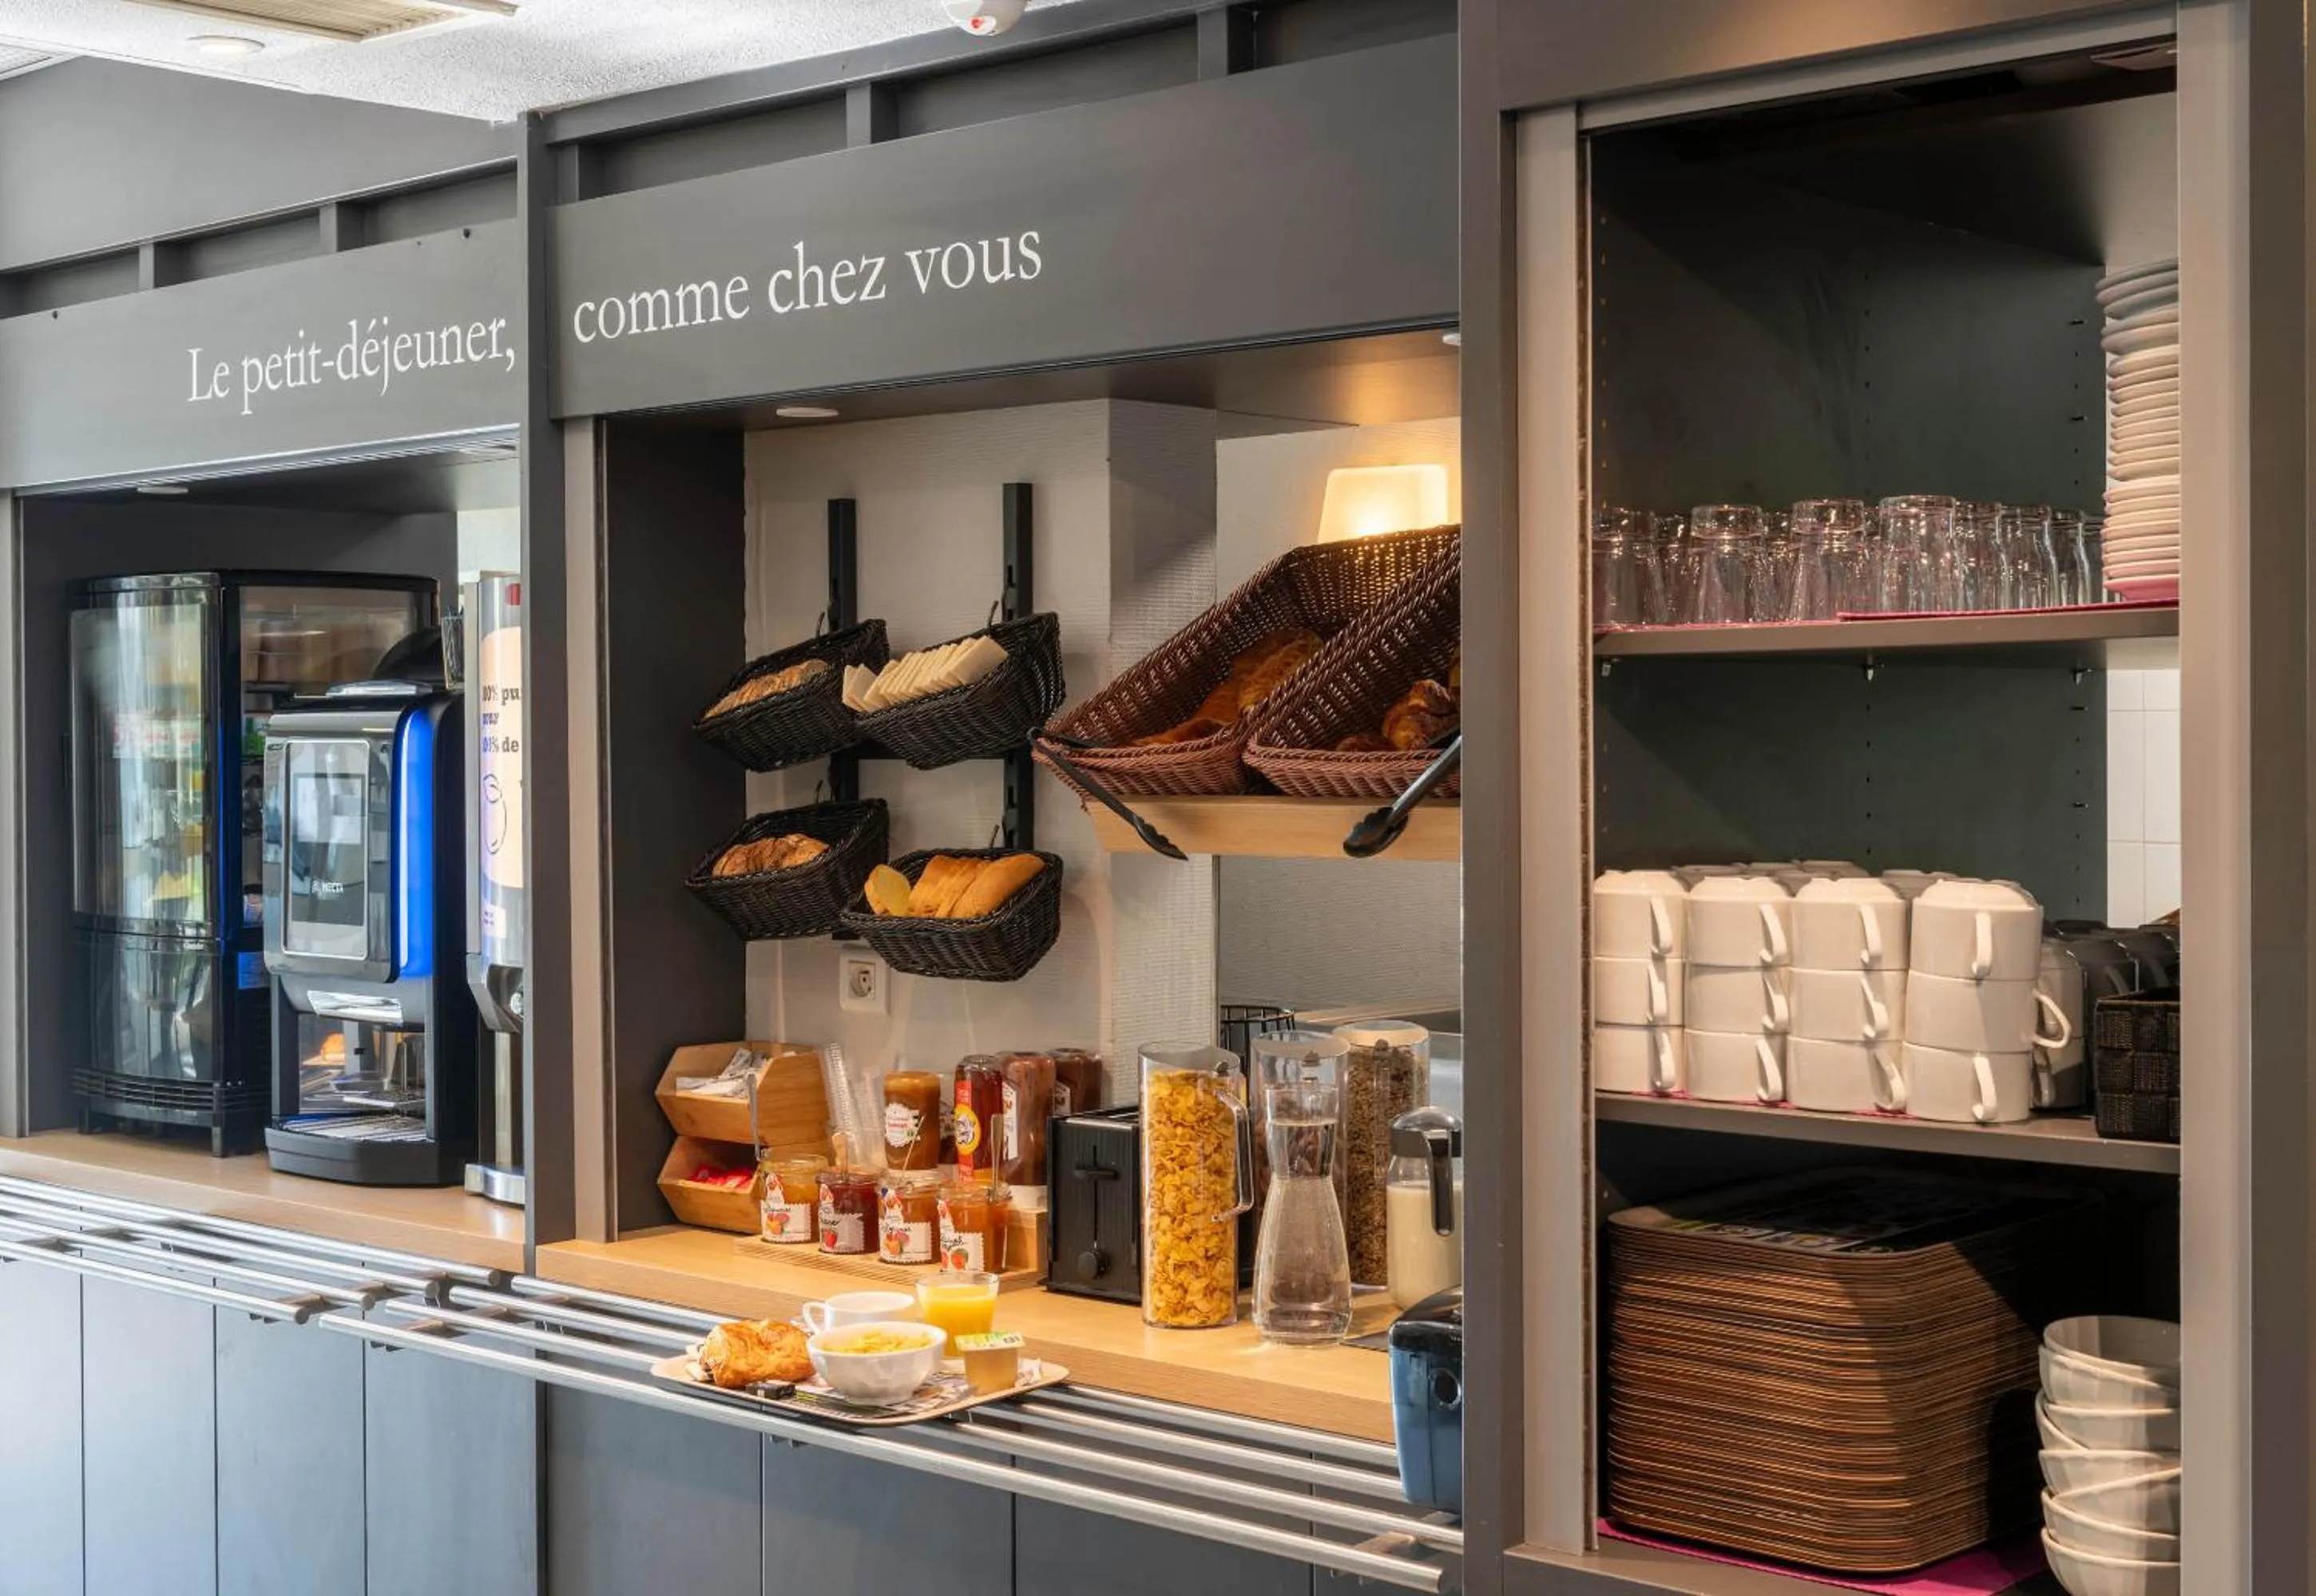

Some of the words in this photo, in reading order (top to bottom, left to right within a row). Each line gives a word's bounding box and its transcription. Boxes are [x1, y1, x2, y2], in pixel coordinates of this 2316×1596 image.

[573, 275, 751, 344] comme
[767, 240, 887, 315] chez
[904, 230, 1041, 295] vous
[188, 347, 230, 402] Le
[240, 317, 516, 414] petit-déjeuner,
[502, 735, 519, 753] de
